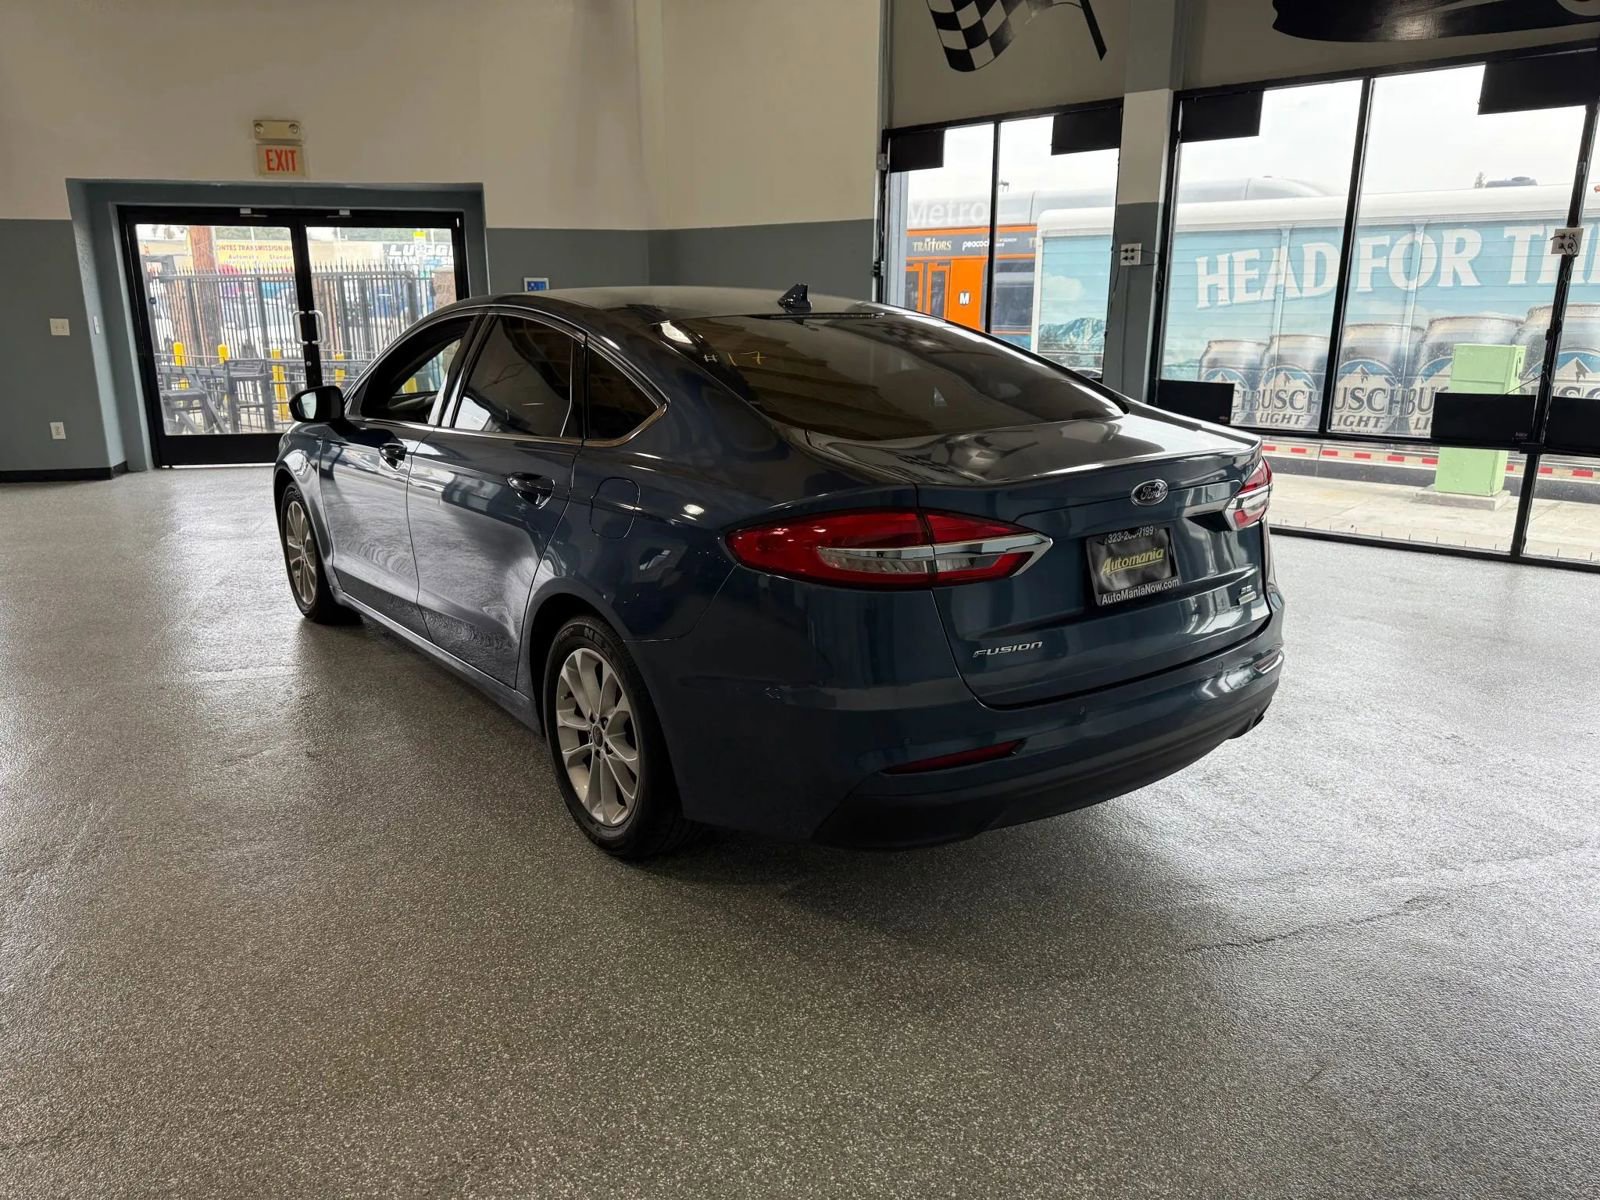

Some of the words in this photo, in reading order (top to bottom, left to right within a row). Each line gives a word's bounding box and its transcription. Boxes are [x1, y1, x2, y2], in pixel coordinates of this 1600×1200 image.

[265, 149, 296, 172] EXIT
[908, 198, 986, 226] Metro
[913, 238, 952, 253] TRAITORS
[1195, 242, 1340, 309] HEAD
[1355, 228, 1481, 293] FOR
[959, 292, 969, 304] M
[1334, 387, 1408, 416] USCH
[1332, 414, 1384, 428] IGHT
[1140, 483, 1164, 500] Ford
[1103, 547, 1164, 576] Automania
[1102, 579, 1180, 605] AutoManiaNow.com
[972, 641, 1043, 658] FUSION
